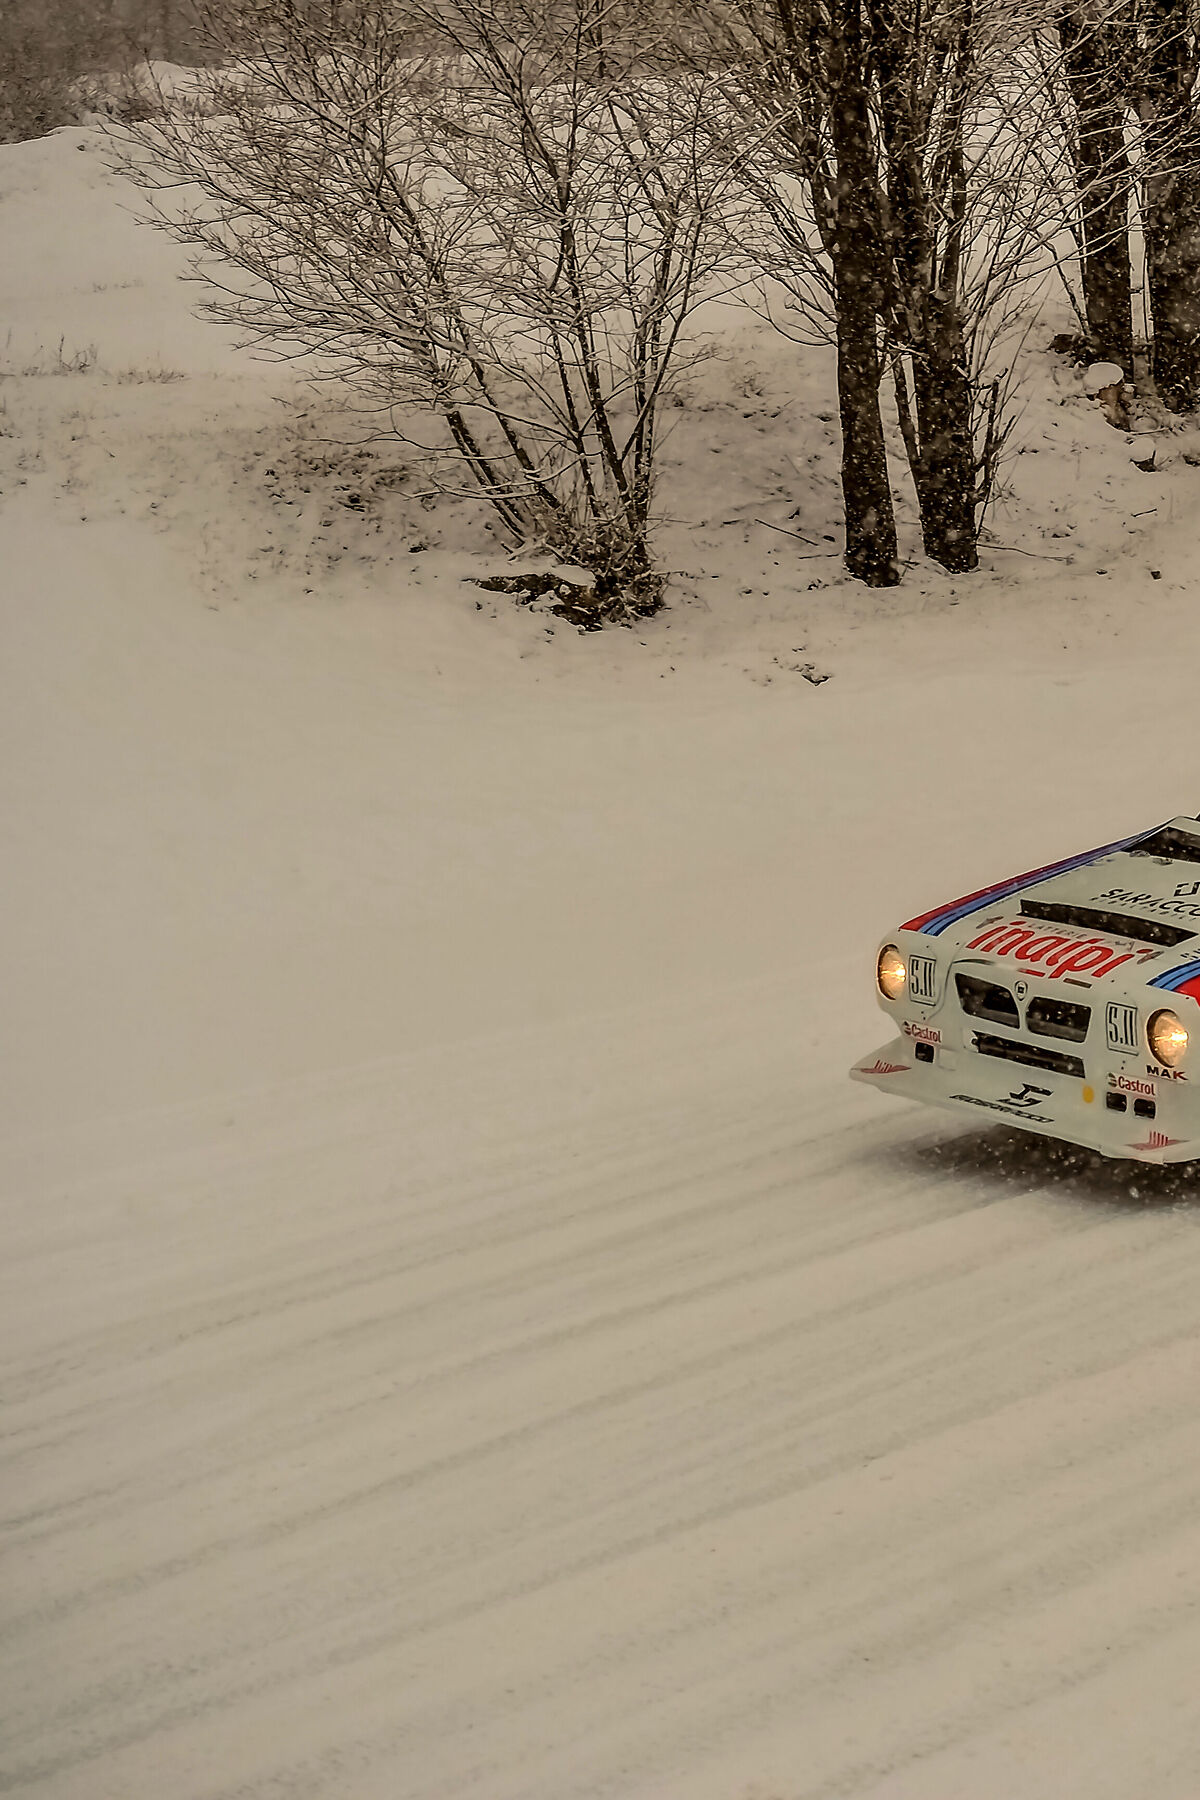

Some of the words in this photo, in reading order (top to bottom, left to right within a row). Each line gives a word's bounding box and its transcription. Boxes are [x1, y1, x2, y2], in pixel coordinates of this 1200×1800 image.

[965, 920, 1154, 980] inalpi
[911, 1023, 942, 1043] Castrol
[1145, 1065, 1190, 1081] MAK
[1118, 1075, 1156, 1096] Castrol
